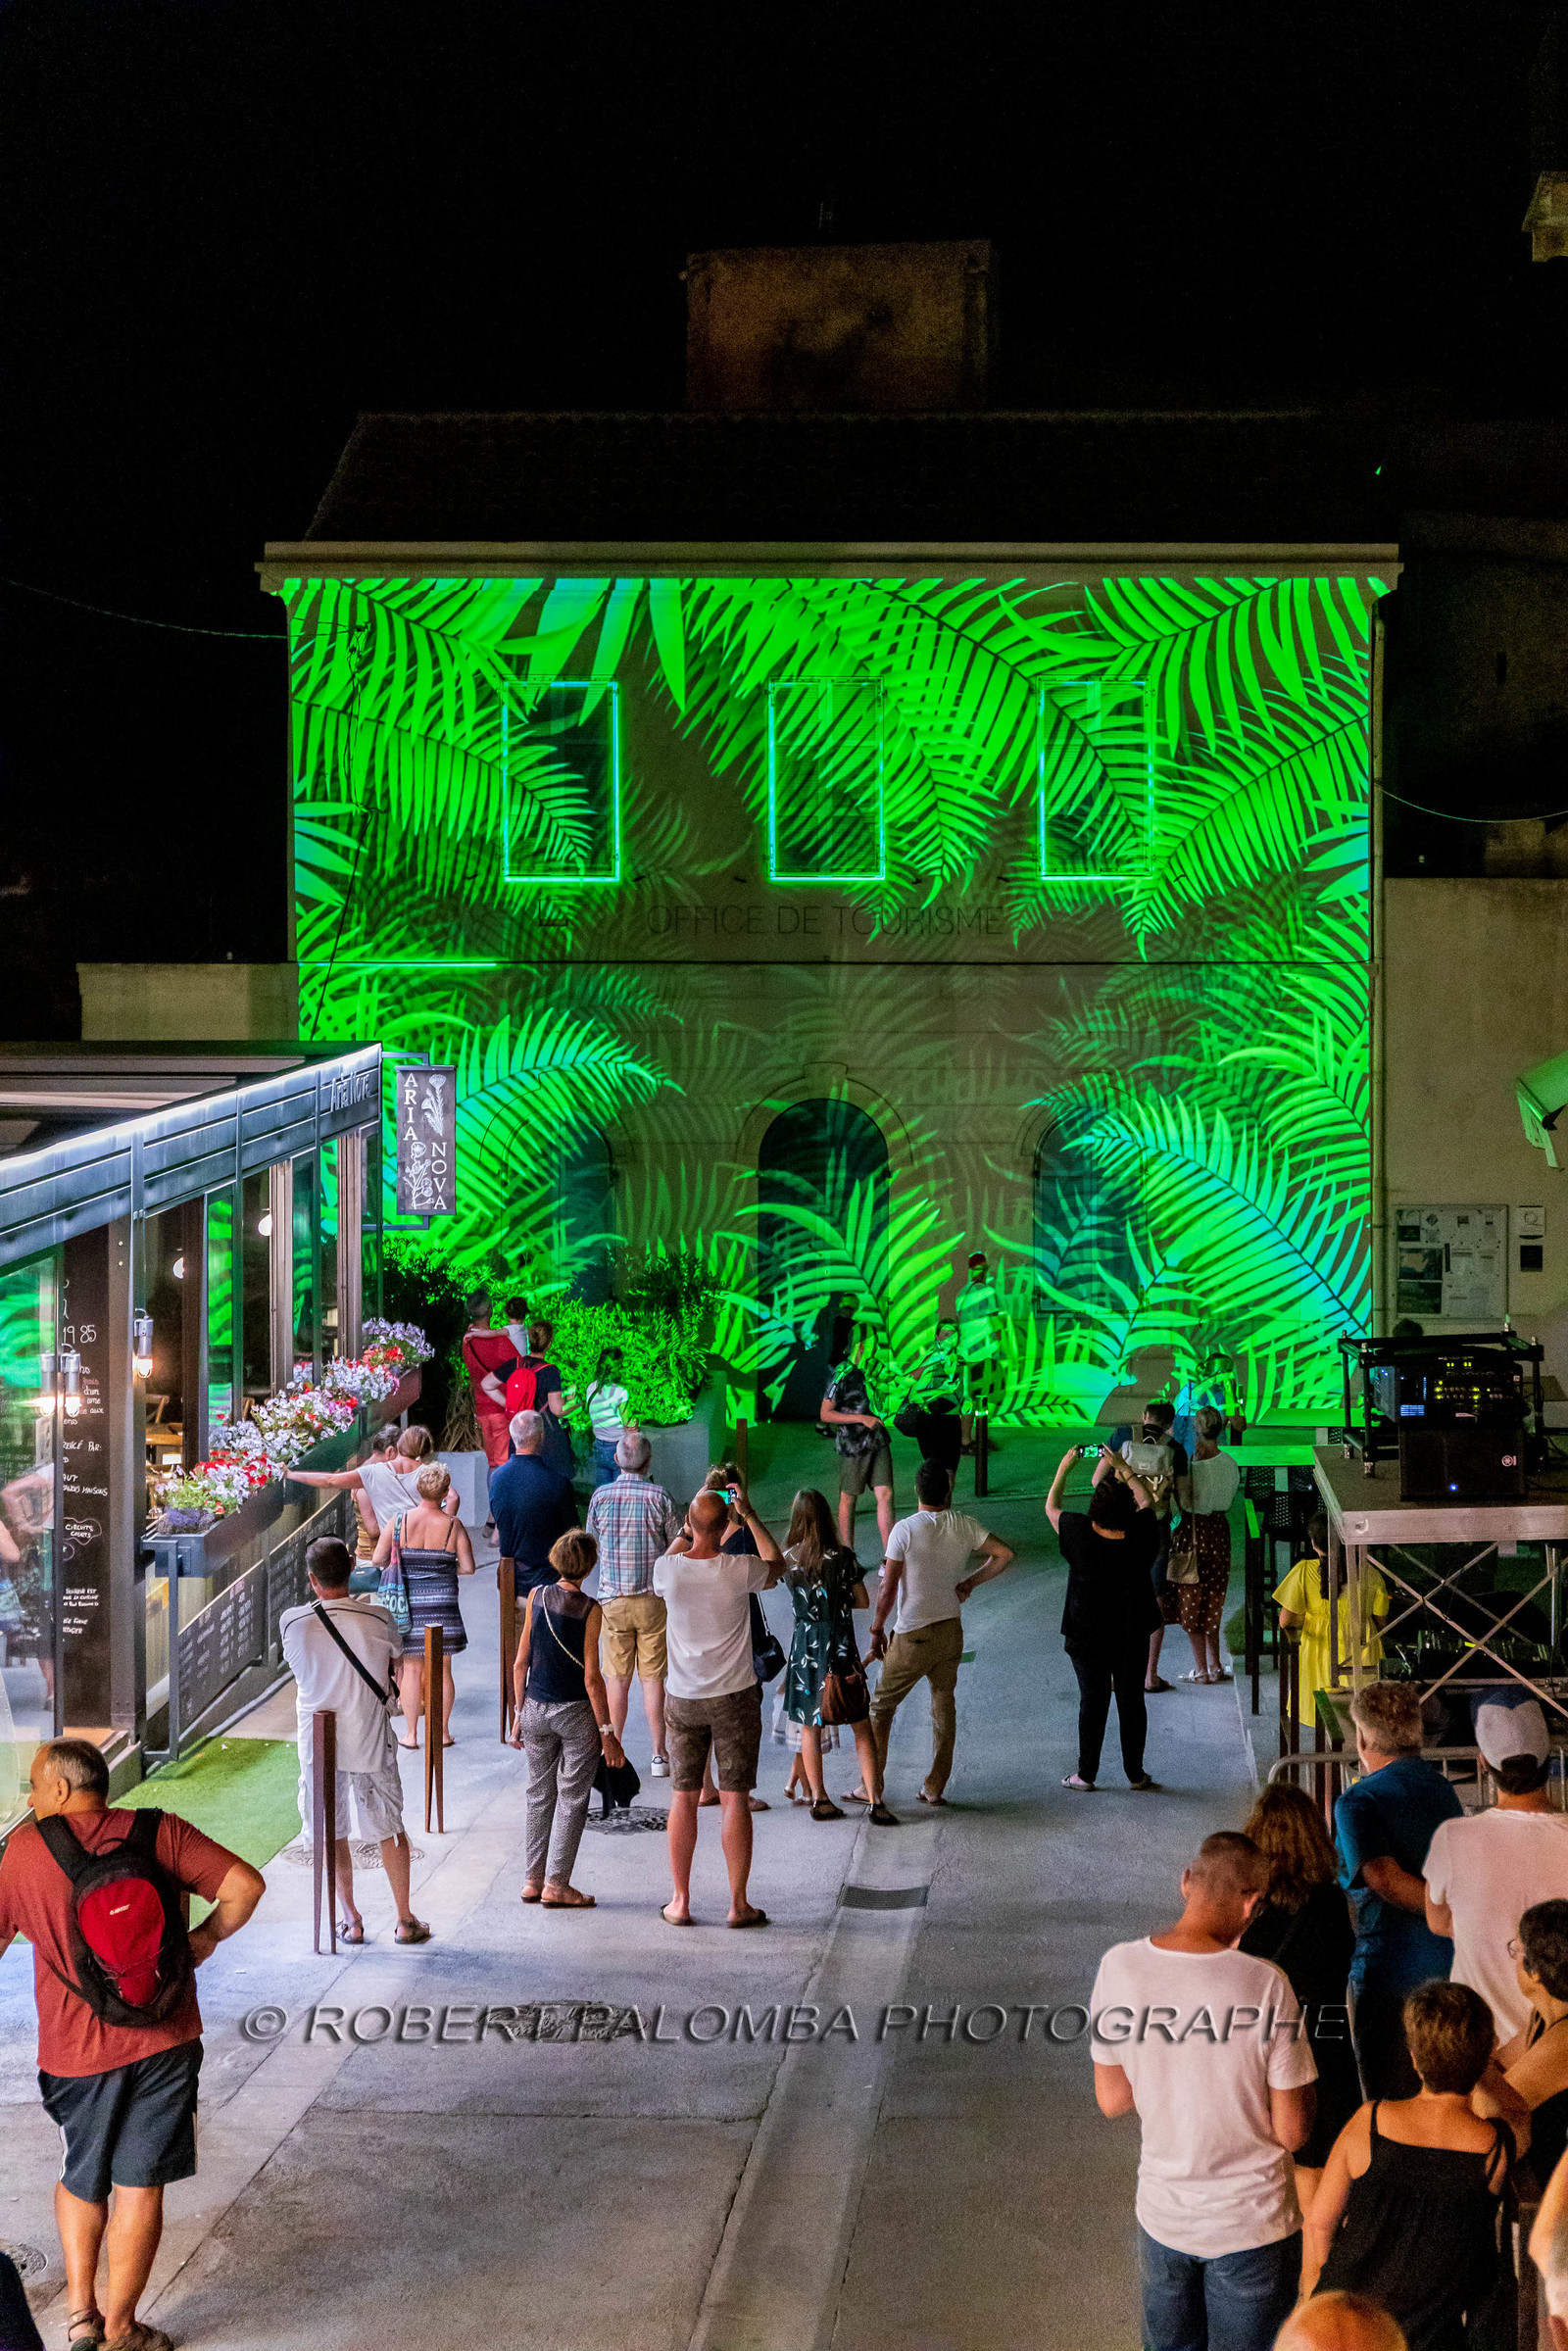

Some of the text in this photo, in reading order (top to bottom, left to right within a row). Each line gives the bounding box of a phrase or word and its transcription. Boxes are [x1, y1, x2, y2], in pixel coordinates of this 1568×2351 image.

[647, 904, 1004, 936] OFFICE DE TOURISME
[403, 1072, 418, 1141] ARIA
[431, 1142, 447, 1210] NOVA
[65, 1524, 94, 1533] CIRCUITS
